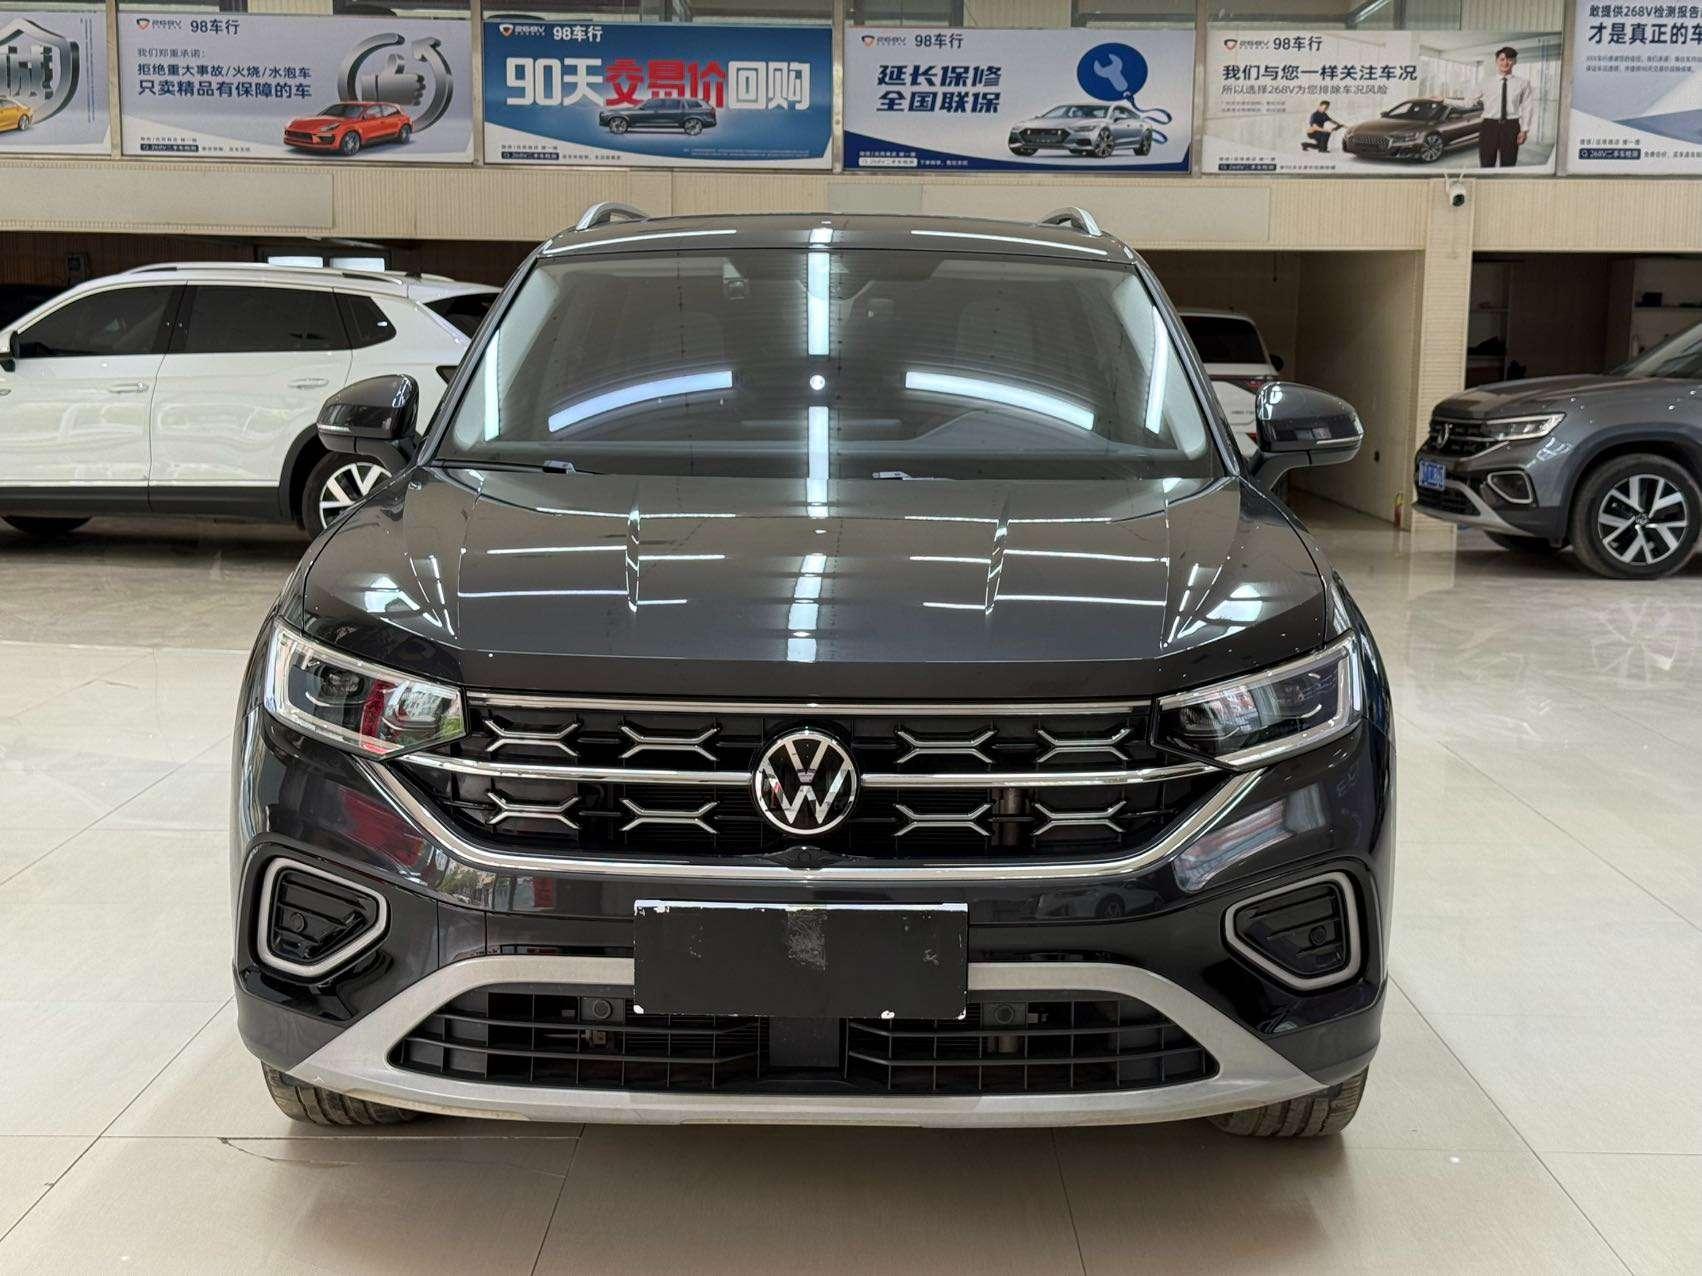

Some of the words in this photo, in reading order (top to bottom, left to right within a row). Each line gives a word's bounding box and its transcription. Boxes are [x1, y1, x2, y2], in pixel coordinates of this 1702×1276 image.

[1589, 4, 1702, 18] 敢提供268V检测报告
[190, 19, 241, 35] 98车行
[553, 25, 603, 42] 98车行
[1588, 22, 1702, 45] 才是真正的车
[914, 33, 964, 49] 98车行
[1273, 36, 1323, 52] 98车行
[137, 63, 312, 79] 拒绝重大事故/火烧/水泡车
[877, 65, 1002, 87] 延长保修
[1222, 65, 1418, 81] 我们与您一样关注车况
[138, 79, 313, 99] 只卖精品有保障的车
[506, 57, 811, 110] 90天交易价回购
[1221, 84, 1388, 96] 所以选择268V为您排除车况风险
[876, 90, 1001, 113] 全国联保
[757, 733, 855, 831] VW
